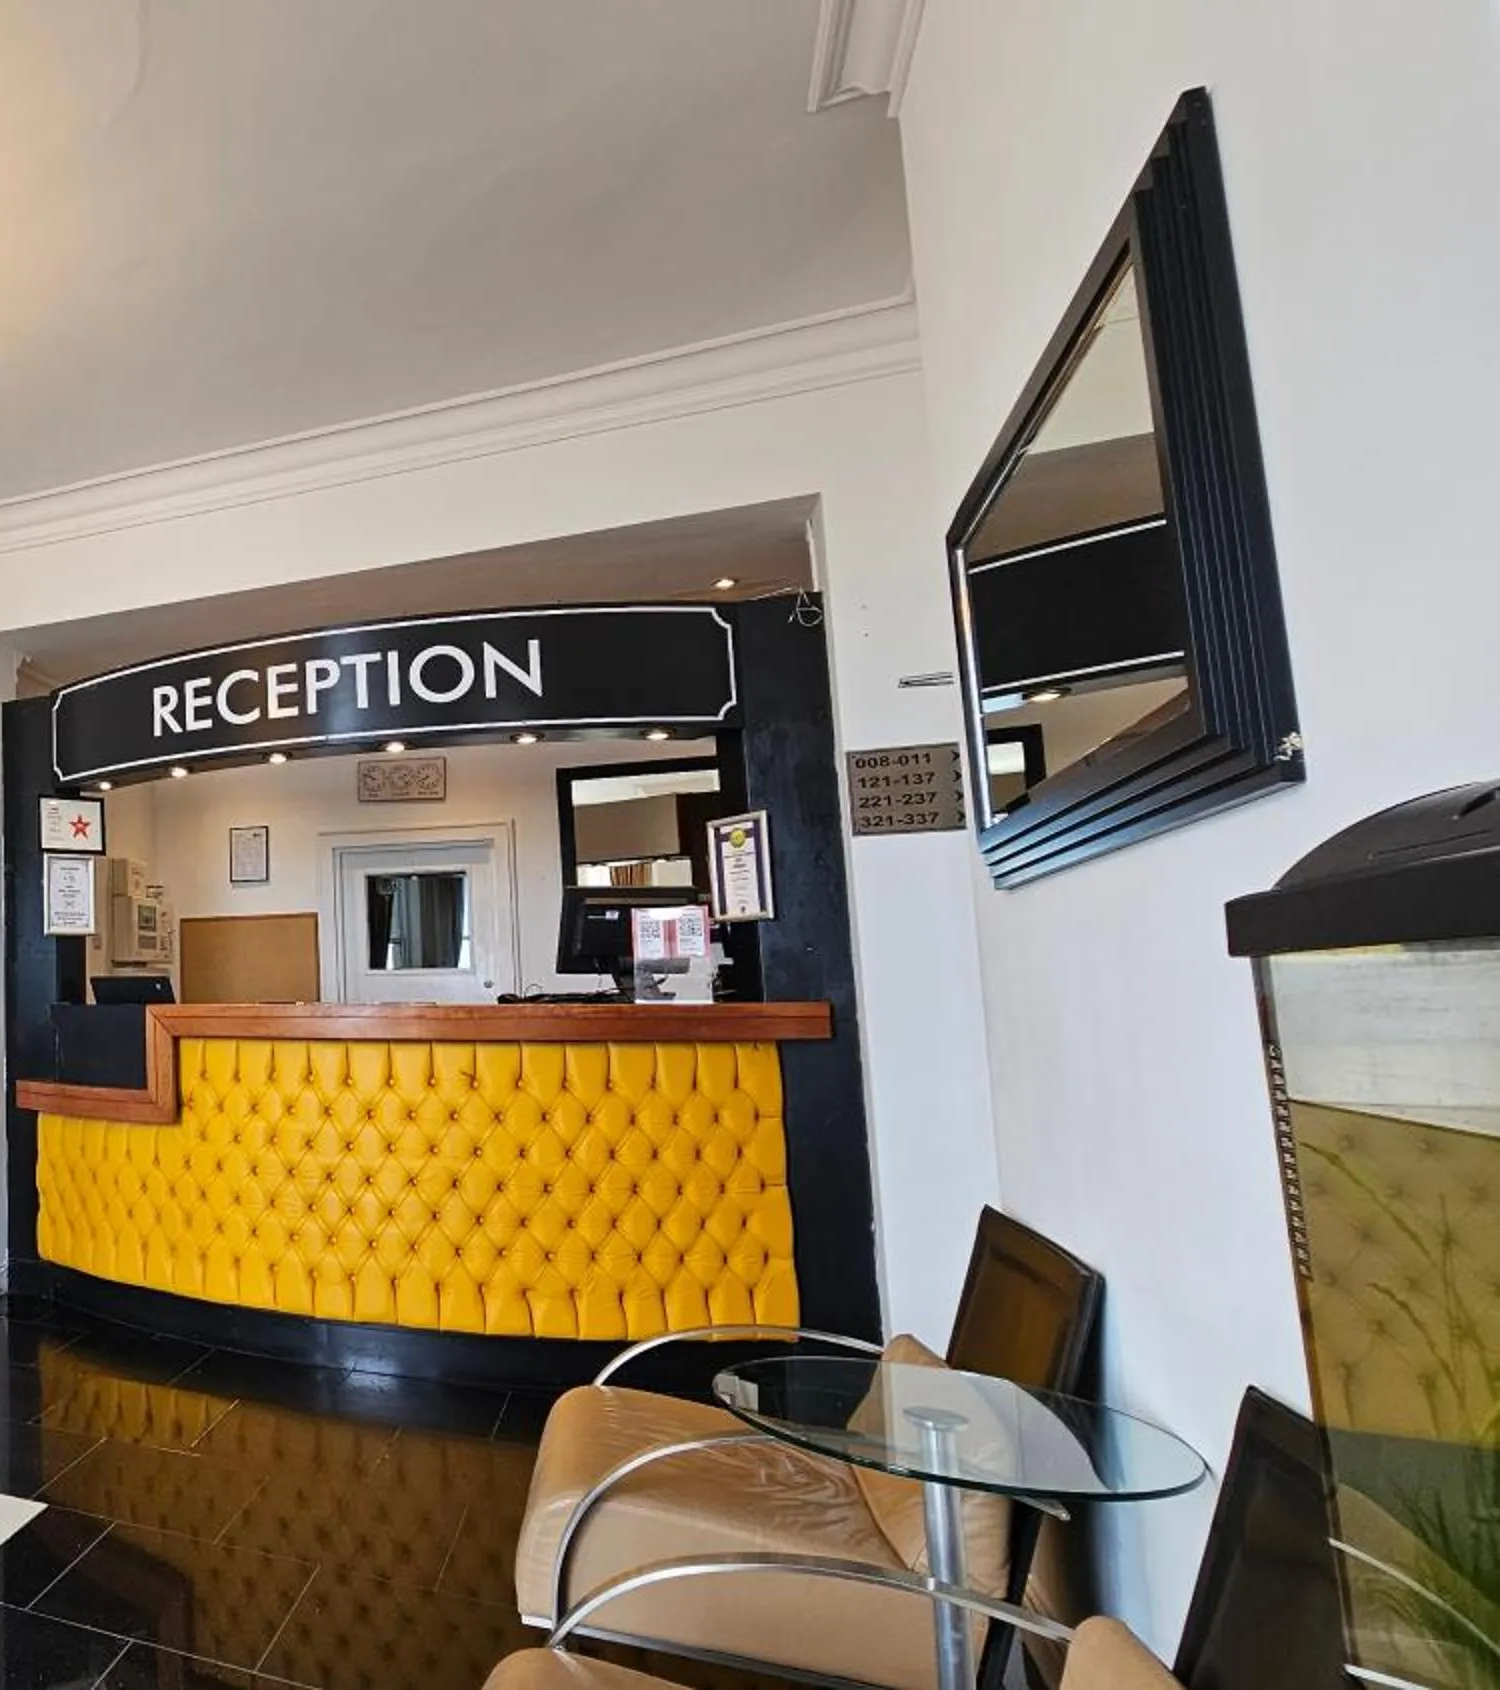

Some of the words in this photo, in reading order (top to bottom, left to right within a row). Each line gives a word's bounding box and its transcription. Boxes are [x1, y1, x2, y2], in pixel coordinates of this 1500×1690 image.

[152, 639, 543, 737] RECEPTION
[855, 753, 931, 769] 008-011
[858, 771, 935, 788] 121-137
[859, 791, 937, 808] 221-237
[860, 811, 939, 829] 321-337
